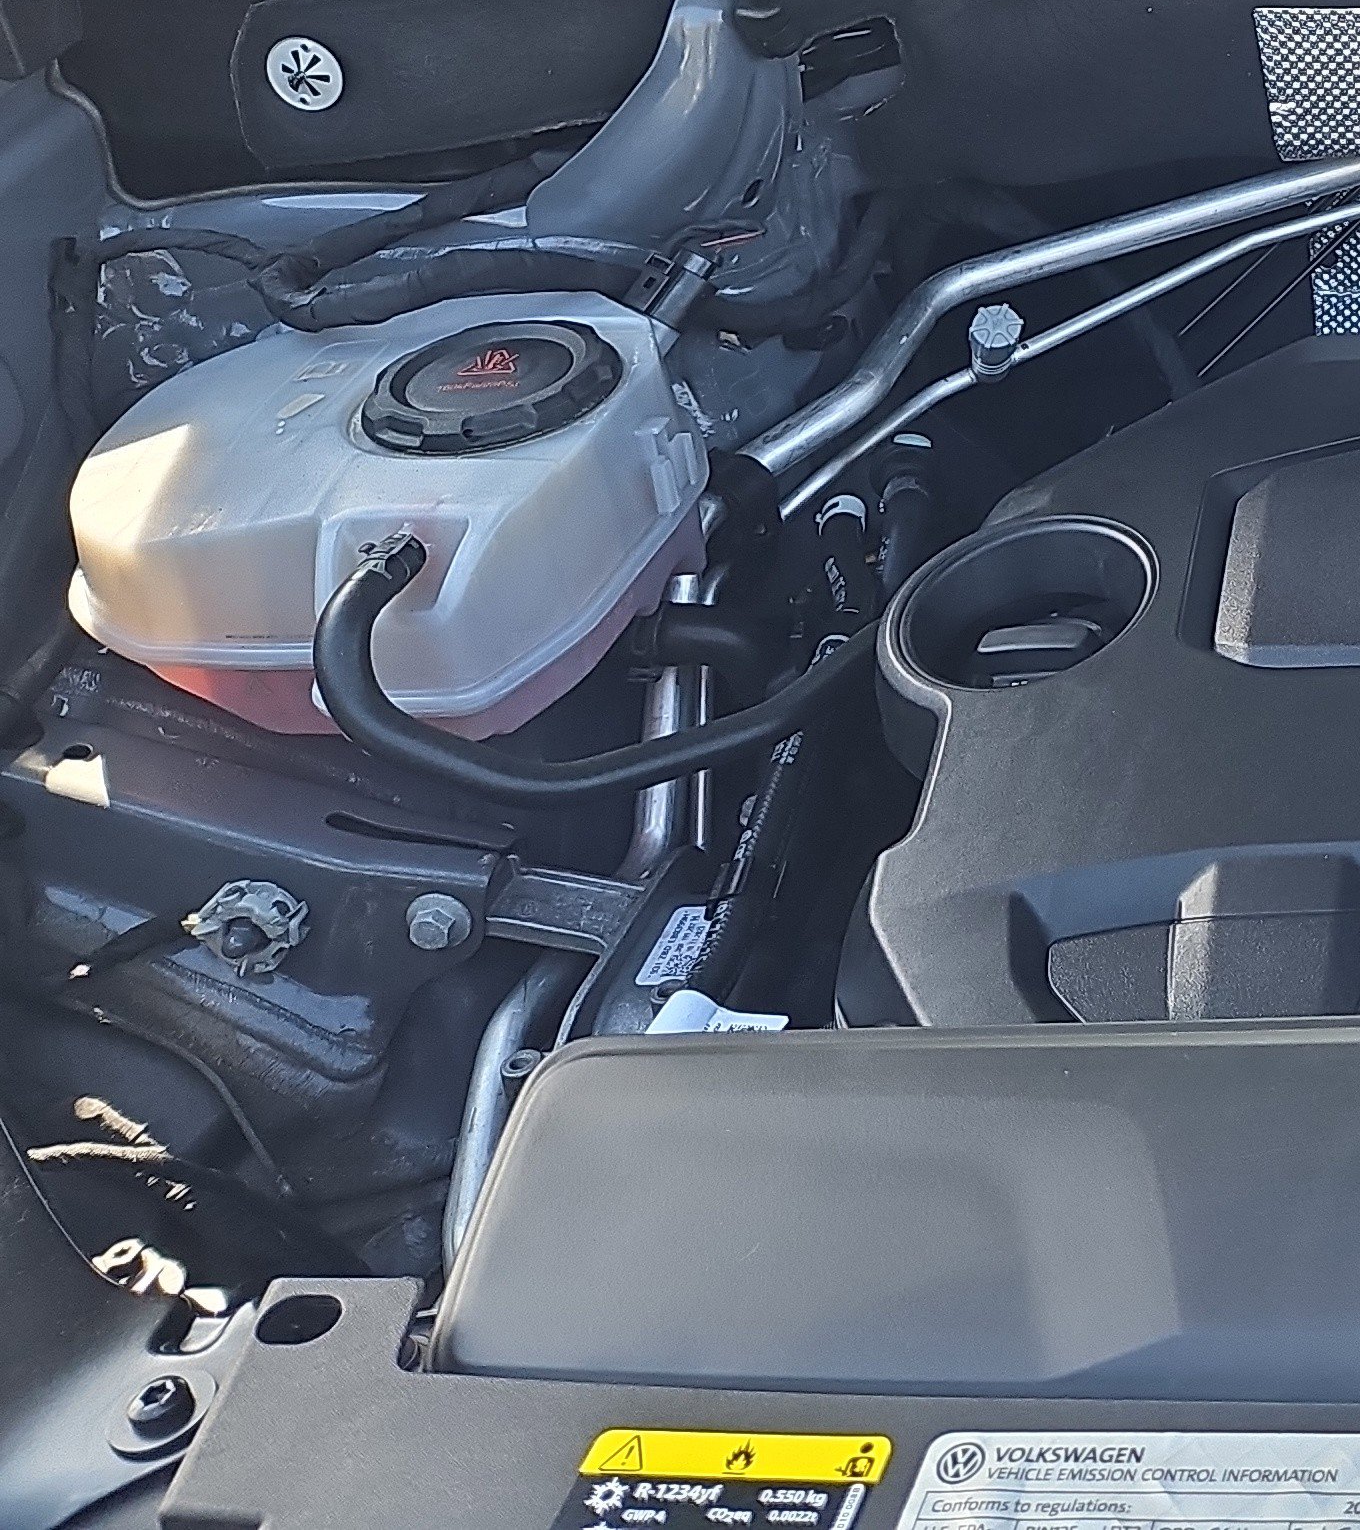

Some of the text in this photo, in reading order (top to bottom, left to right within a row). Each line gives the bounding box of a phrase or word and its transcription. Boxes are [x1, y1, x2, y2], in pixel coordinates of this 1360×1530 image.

[994, 1446, 1146, 1464] VOLKSWAGEN
[986, 1467, 1339, 1483] VEHICLE EMISSION CONTROL INFORMATION
[633, 1482, 829, 1510] R-1234yf 0.550 kg
[931, 1496, 1132, 1517] Conforms to regulations:
